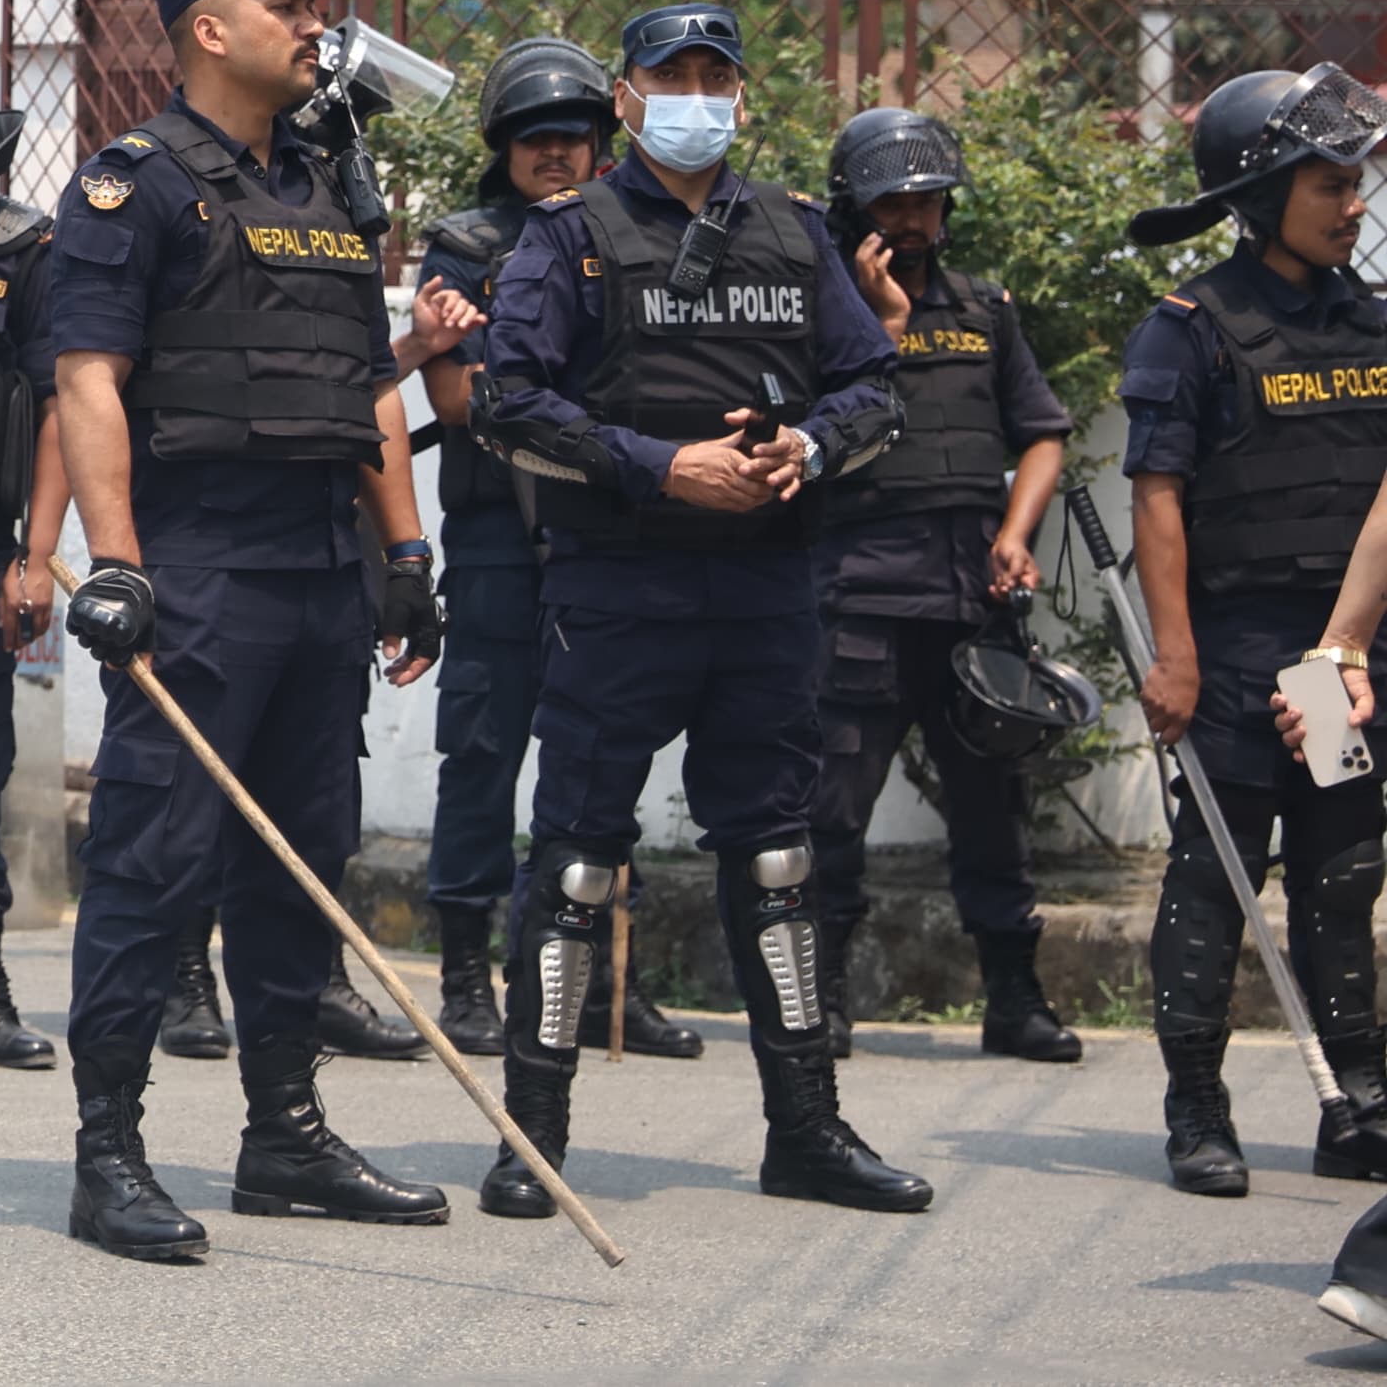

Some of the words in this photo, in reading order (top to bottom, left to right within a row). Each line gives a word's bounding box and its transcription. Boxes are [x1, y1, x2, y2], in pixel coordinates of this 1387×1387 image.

[246, 226, 309, 256] NEPAL
[308, 229, 370, 260] POLICE
[643, 288, 723, 324] NEPAL
[728, 286, 804, 324] POLICE
[899, 331, 933, 355] PAL
[1262, 371, 1331, 406] NEPAL
